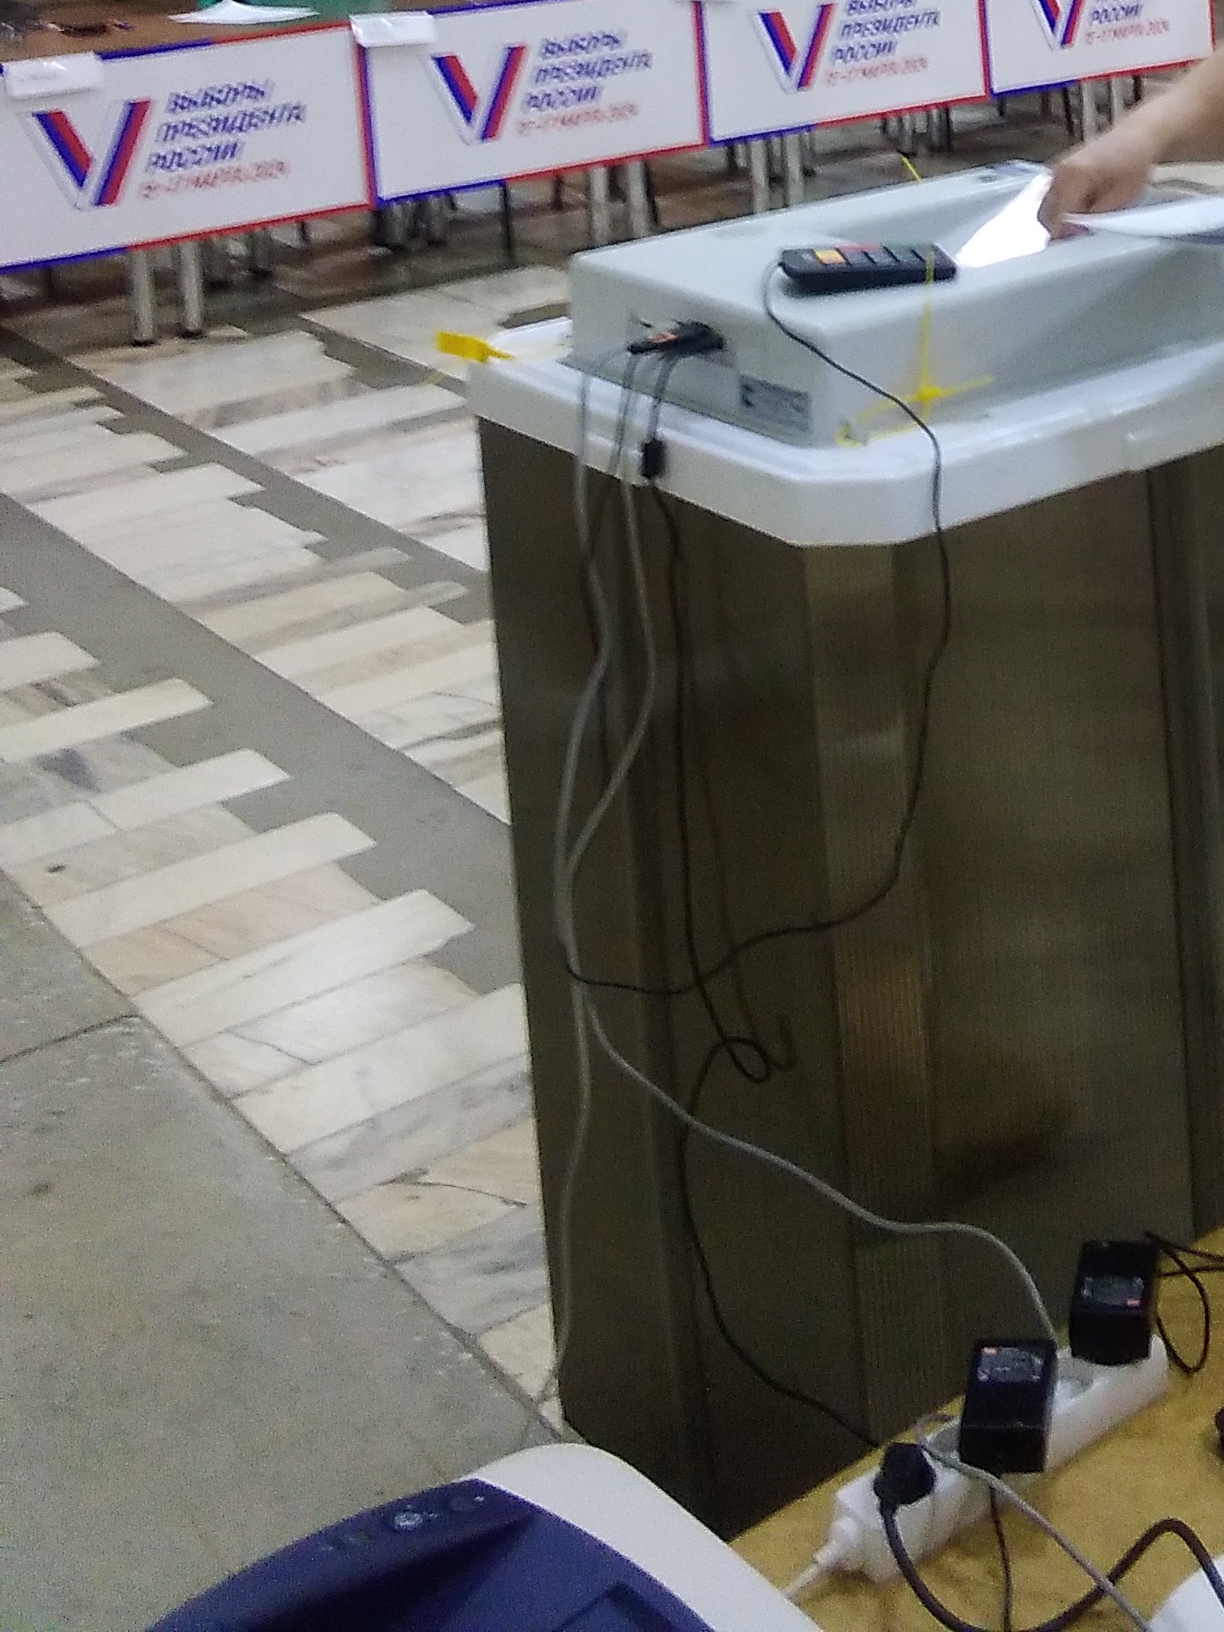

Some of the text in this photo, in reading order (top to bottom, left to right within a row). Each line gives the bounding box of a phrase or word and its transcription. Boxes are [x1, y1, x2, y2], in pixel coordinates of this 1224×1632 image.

[840, 9, 940, 39] ПРЕЗИДЕНТА
[1090, 4, 1142, 25] РОССИИ
[831, 41, 897, 65] РОССИИ
